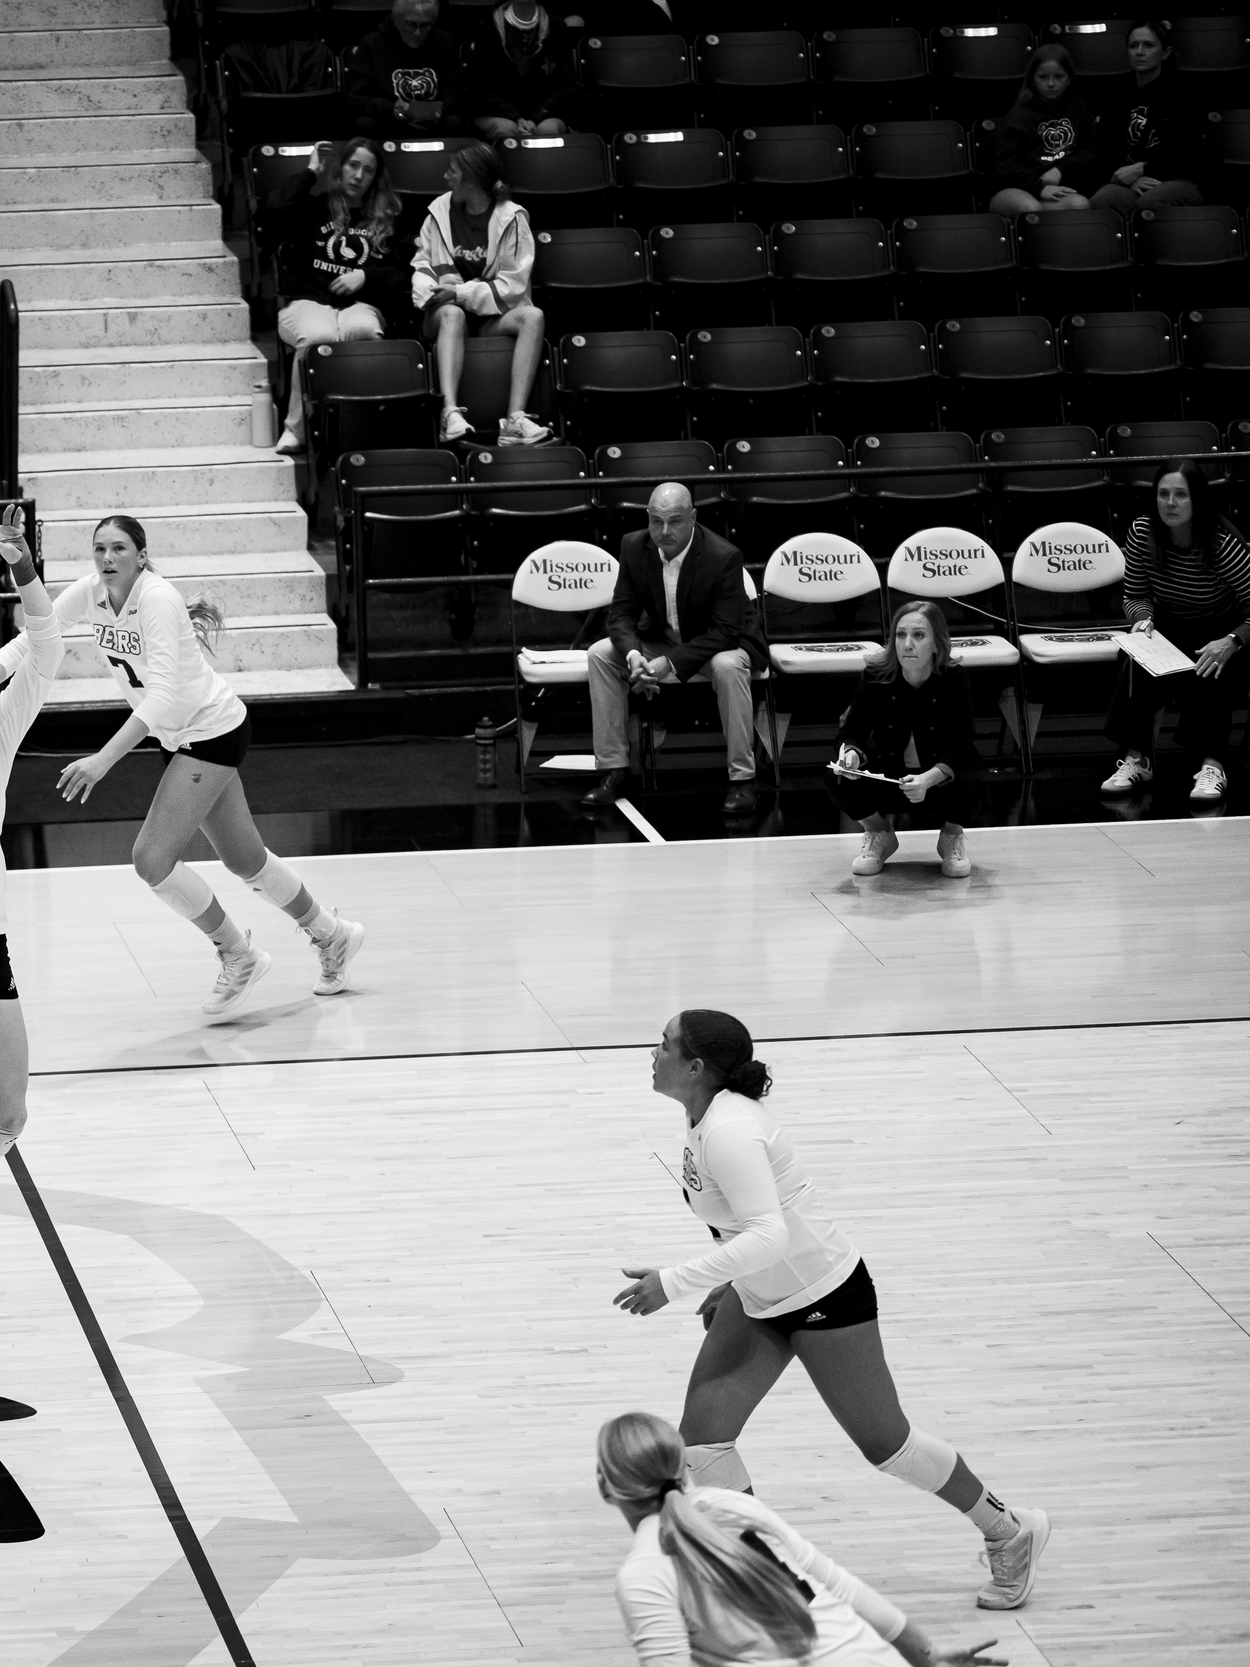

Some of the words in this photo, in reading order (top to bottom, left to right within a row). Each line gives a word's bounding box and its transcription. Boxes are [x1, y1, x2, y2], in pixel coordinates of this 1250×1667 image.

[904, 546, 986, 562] Missouri
[1029, 540, 1110, 557] Missouri
[530, 559, 611, 574] Missouri
[780, 550, 862, 566] Missouri
[1047, 556, 1094, 573] State
[798, 566, 845, 583] State
[922, 562, 969, 579] State
[548, 575, 595, 591] State
[106, 654, 145, 689] 7
